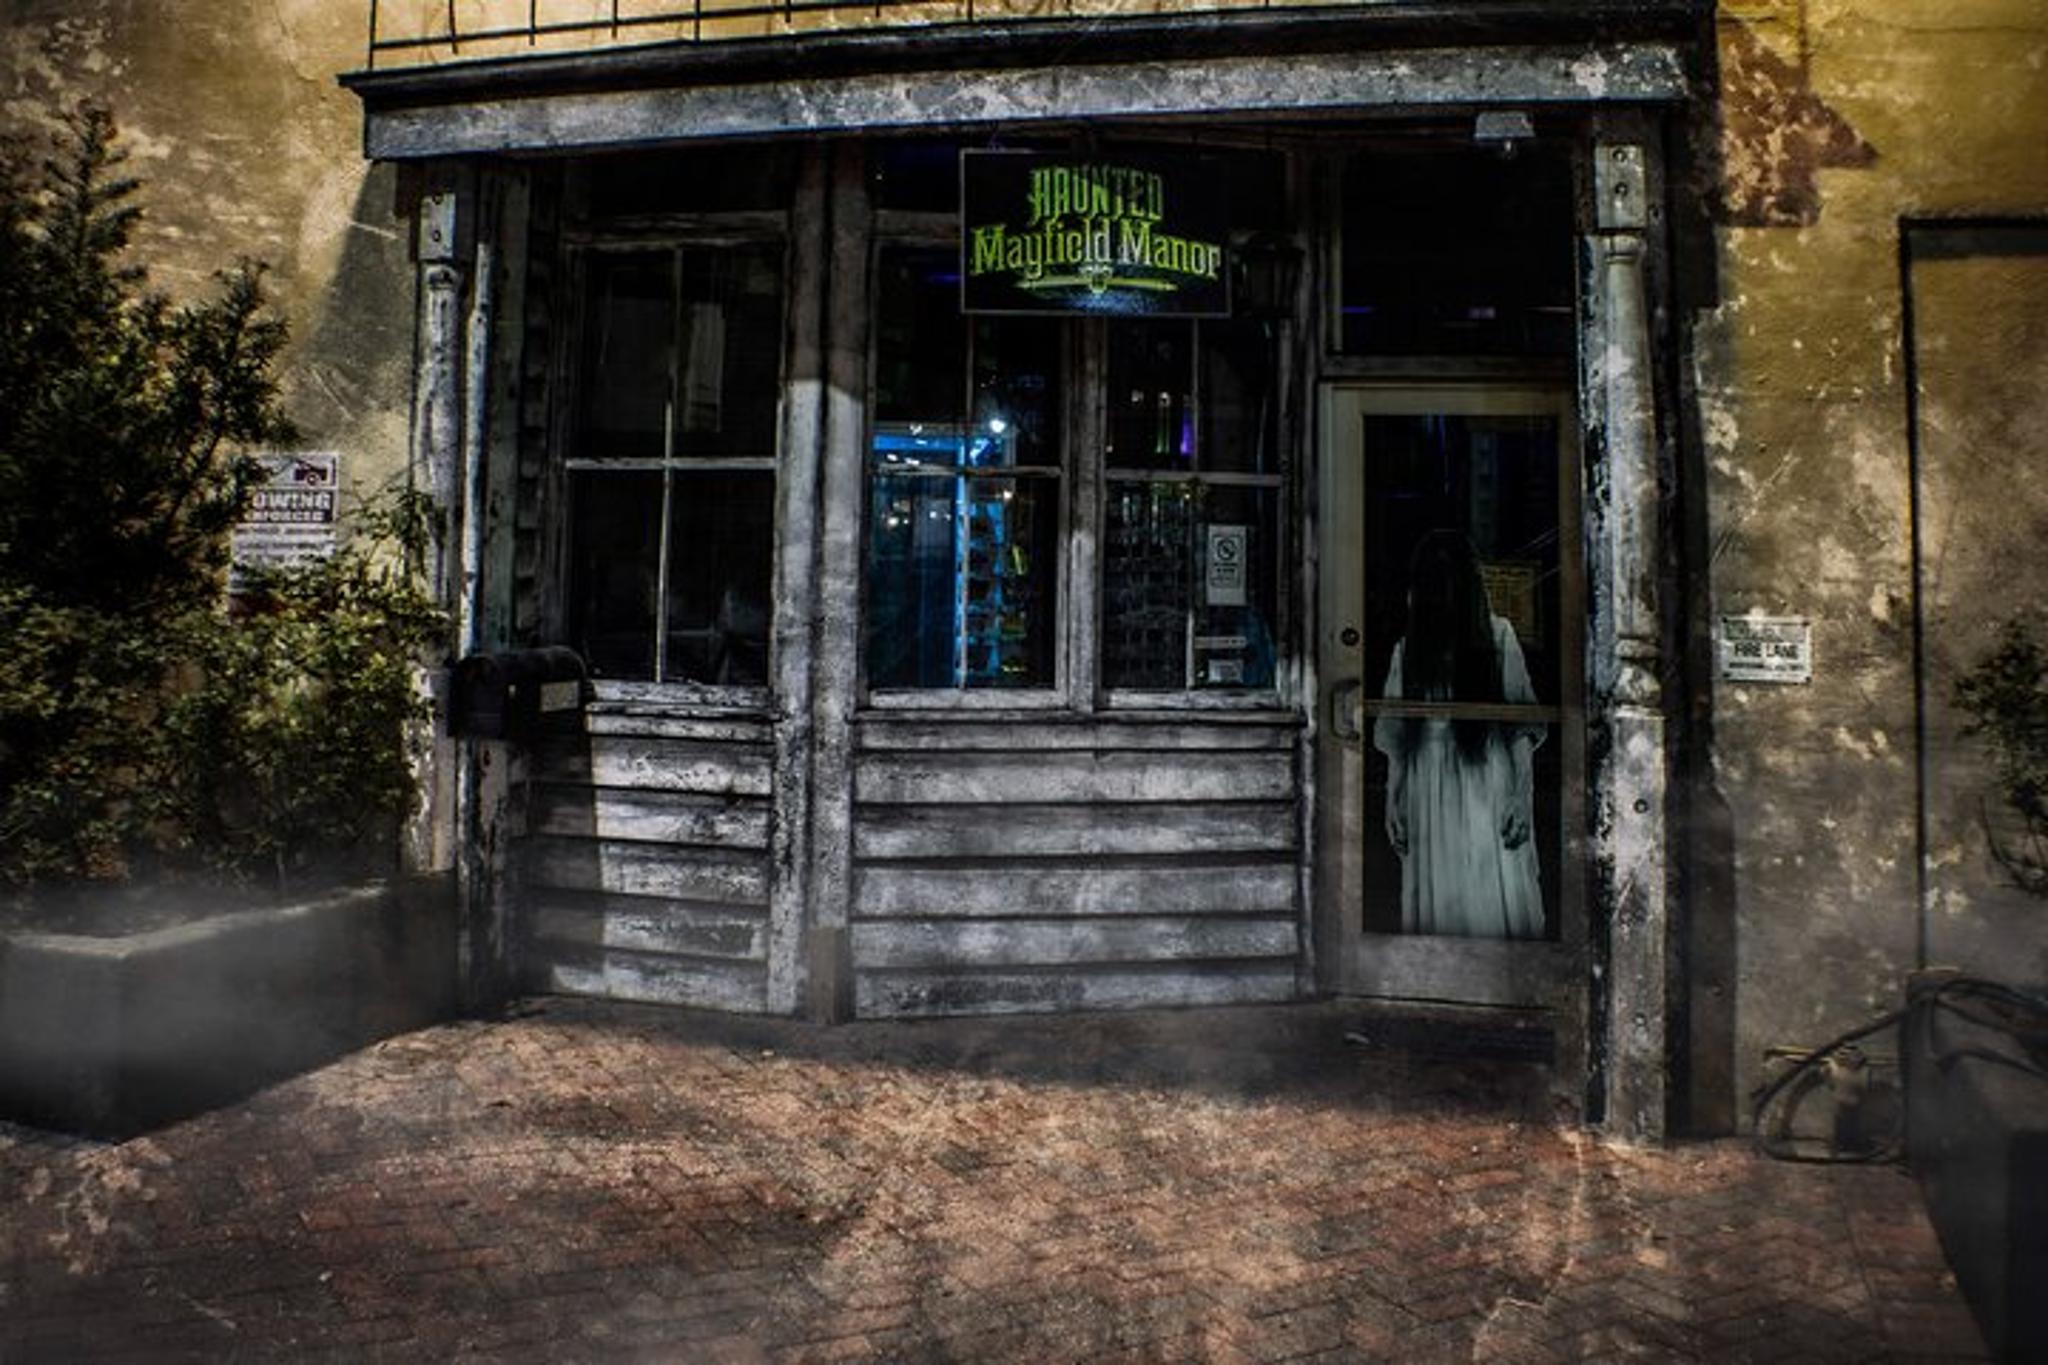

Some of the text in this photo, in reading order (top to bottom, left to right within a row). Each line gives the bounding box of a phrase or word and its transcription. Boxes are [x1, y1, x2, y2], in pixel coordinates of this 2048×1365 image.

[1027, 164, 1164, 226] HAUNTED
[970, 217, 1222, 279] Mayfield Manor
[244, 491, 331, 510] OWING
